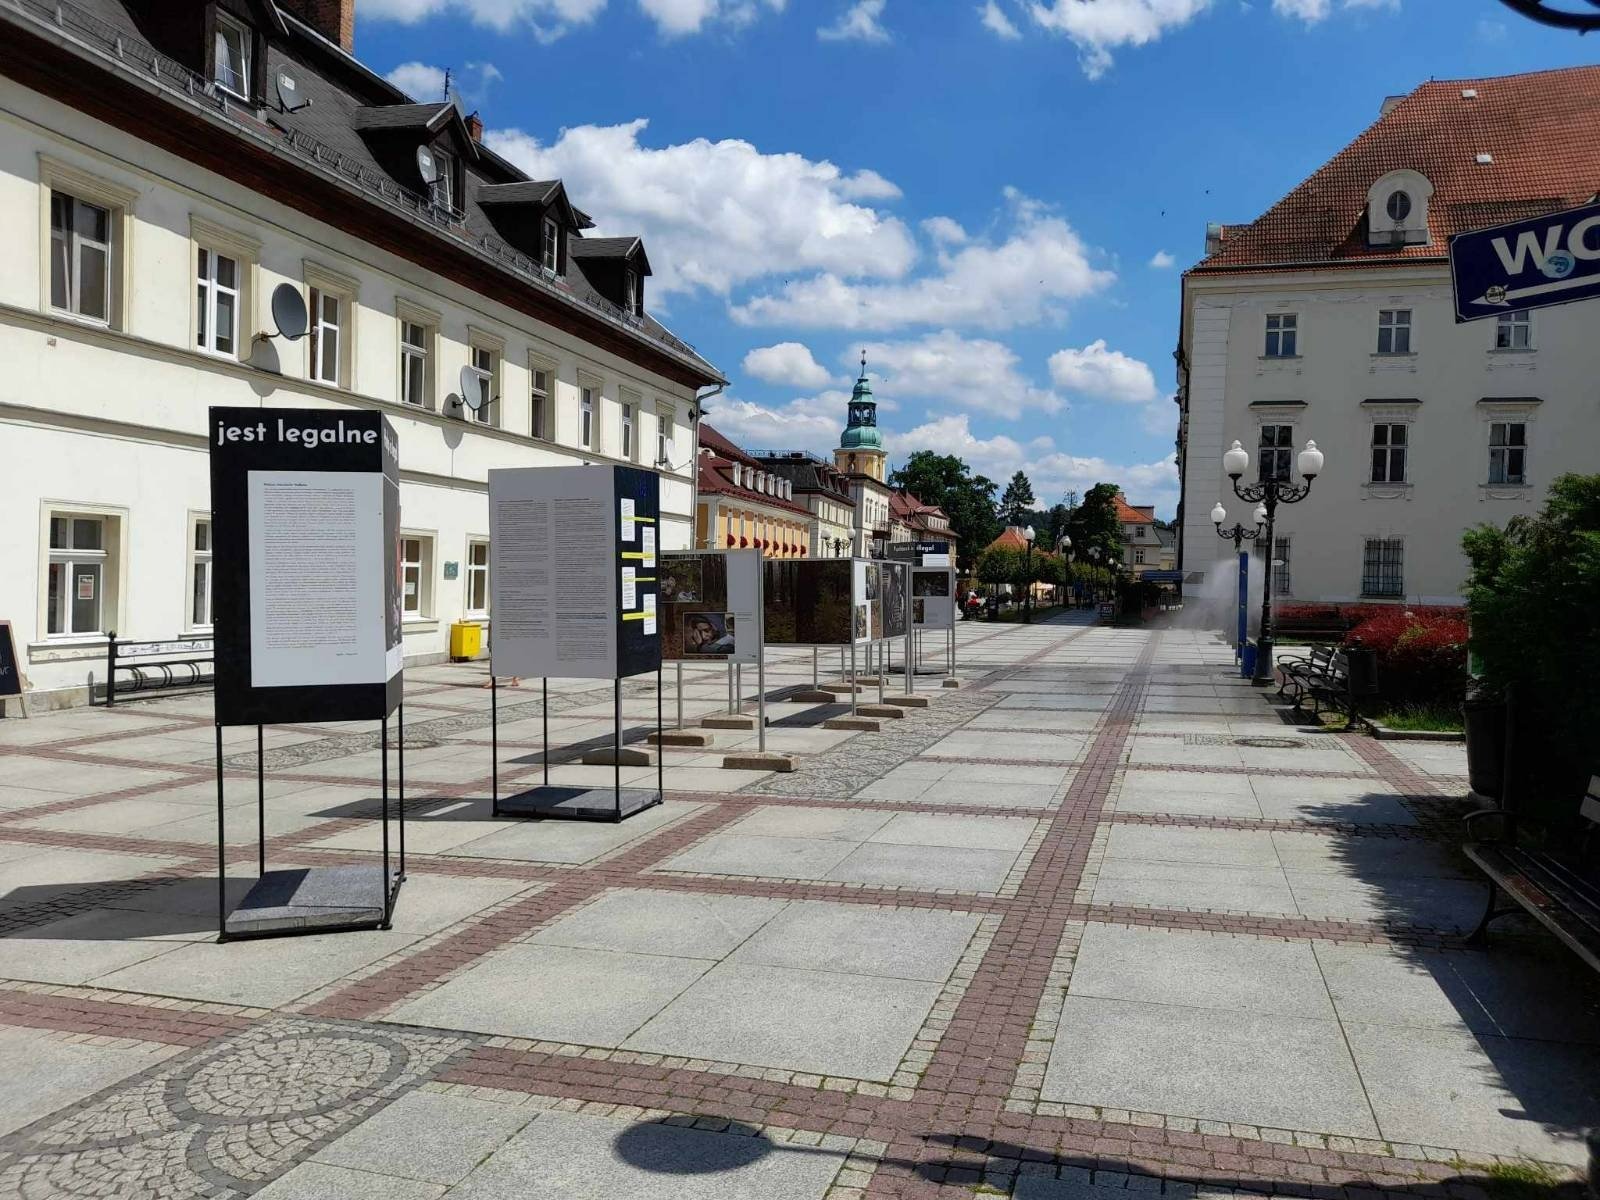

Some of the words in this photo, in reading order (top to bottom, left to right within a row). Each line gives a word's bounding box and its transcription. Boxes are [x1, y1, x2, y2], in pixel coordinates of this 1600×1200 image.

[1491, 215, 1600, 275] WC
[217, 421, 267, 446] jest
[278, 418, 378, 448] legalne
